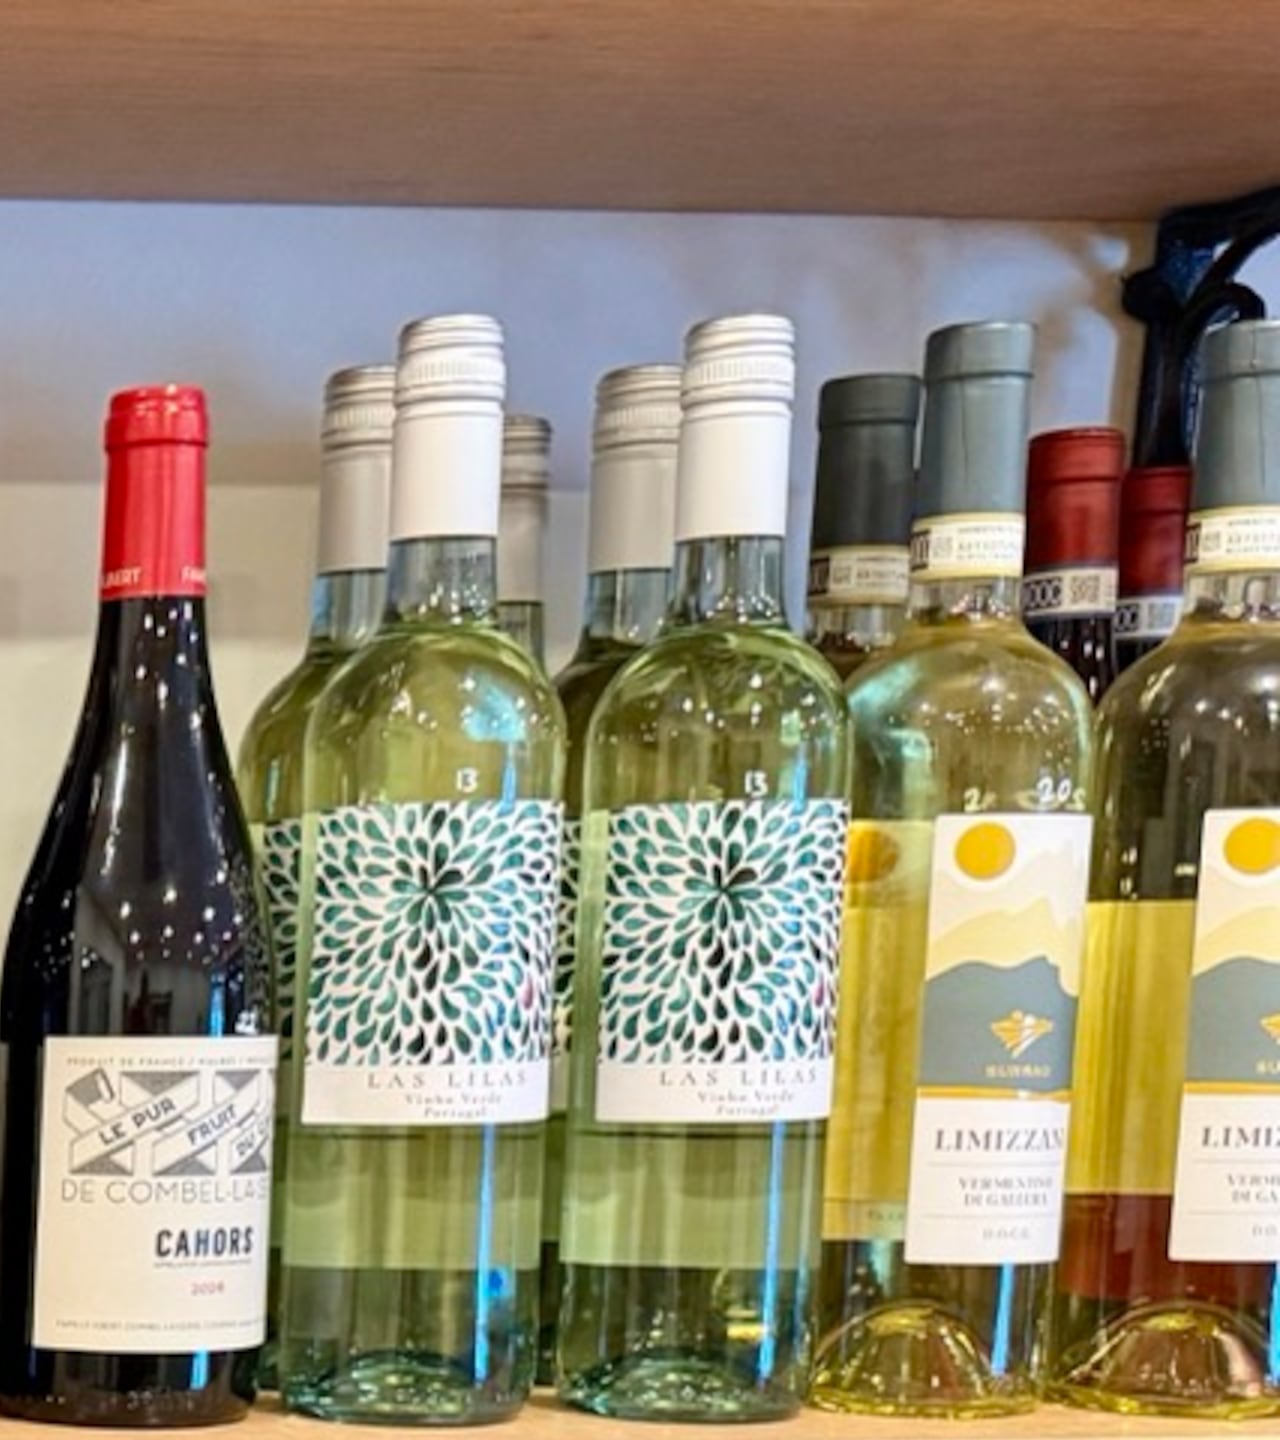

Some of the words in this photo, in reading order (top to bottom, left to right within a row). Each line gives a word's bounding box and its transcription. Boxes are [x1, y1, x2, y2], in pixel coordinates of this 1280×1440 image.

[367, 1071, 426, 1089] LAS
[448, 1070, 527, 1088] LILAS
[660, 1070, 718, 1086] LAS
[741, 1067, 817, 1085] LILAS
[98, 1123, 124, 1147] LE
[131, 1097, 176, 1130] PUR
[186, 1103, 238, 1146] FRUIT
[61, 1180, 96, 1202] DE
[156, 1226, 253, 1257] CAHORS
